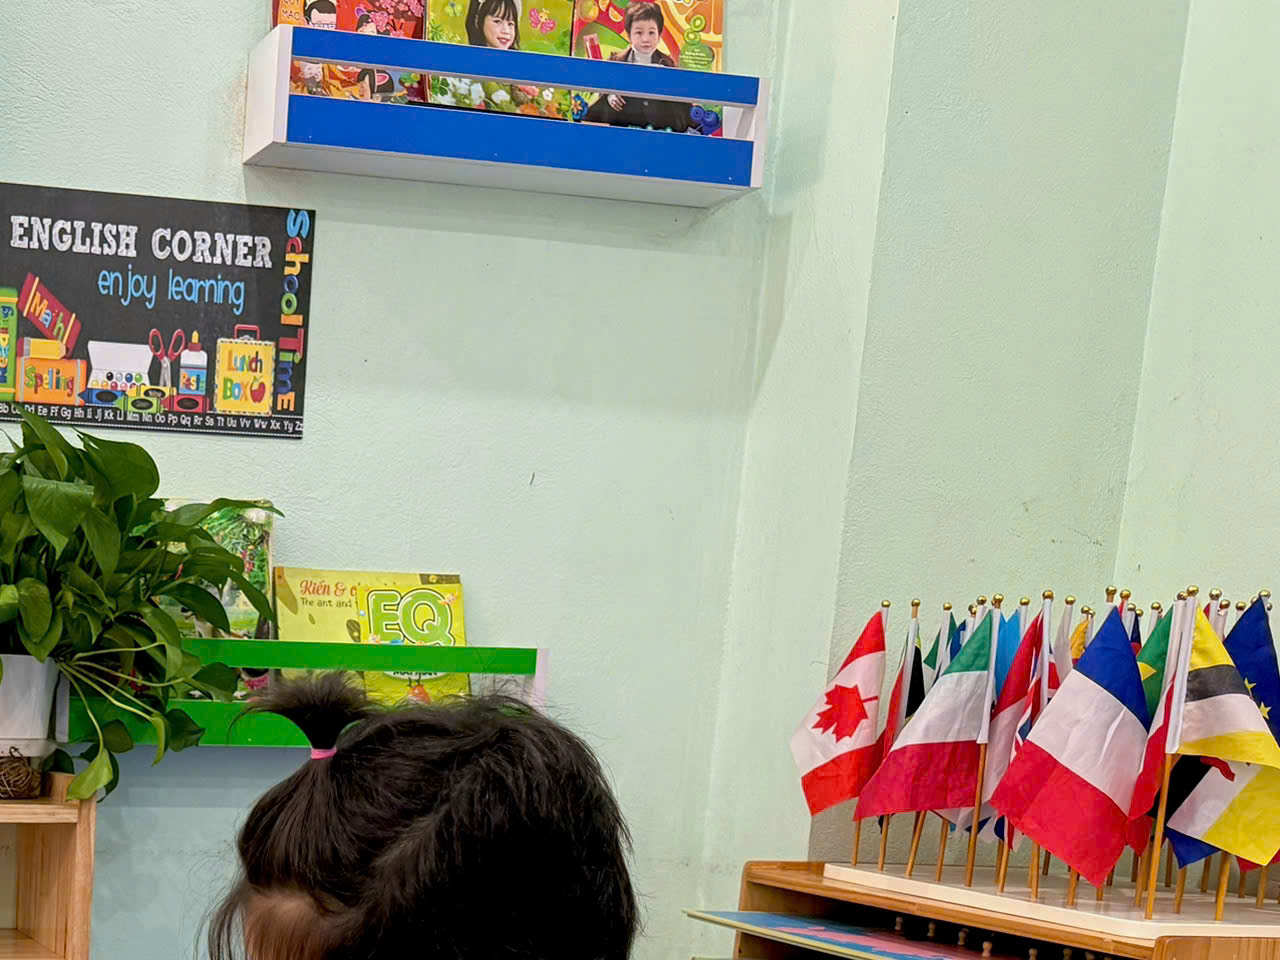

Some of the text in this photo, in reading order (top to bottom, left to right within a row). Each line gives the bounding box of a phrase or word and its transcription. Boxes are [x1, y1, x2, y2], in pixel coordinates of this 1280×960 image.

[10, 215, 272, 269] ENGLISH CORNER
[98, 263, 246, 316] enjoy learning
[38, 406, 48, 416] Ee
[50, 406, 59, 416] Ff
[61, 407, 71, 419] Gg
[74, 408, 84, 418] Hh
[95, 409, 102, 421] Jj
[104, 409, 114, 420] Kk
[126, 411, 140, 422] Mm
[142, 412, 153, 422] Nn
[155, 413, 165, 423] Oo
[168, 414, 178, 425] Pp
[180, 415, 191, 427] Qq
[194, 416, 203, 425] Rr
[205, 416, 214, 426] Ss
[217, 417, 224, 427] Tt
[227, 417, 237, 427] Uu
[239, 418, 250, 428] Vv
[254, 419, 268, 429] Ww
[270, 419, 280, 430] Xx
[283, 420, 293, 433] Yy
[295, 421, 304, 431] Zz
[301, 597, 314, 607] The
[317, 599, 332, 608] ant
[336, 600, 352, 608] and
[334, 582, 347, 596] &
[368, 588, 456, 646] EQ
